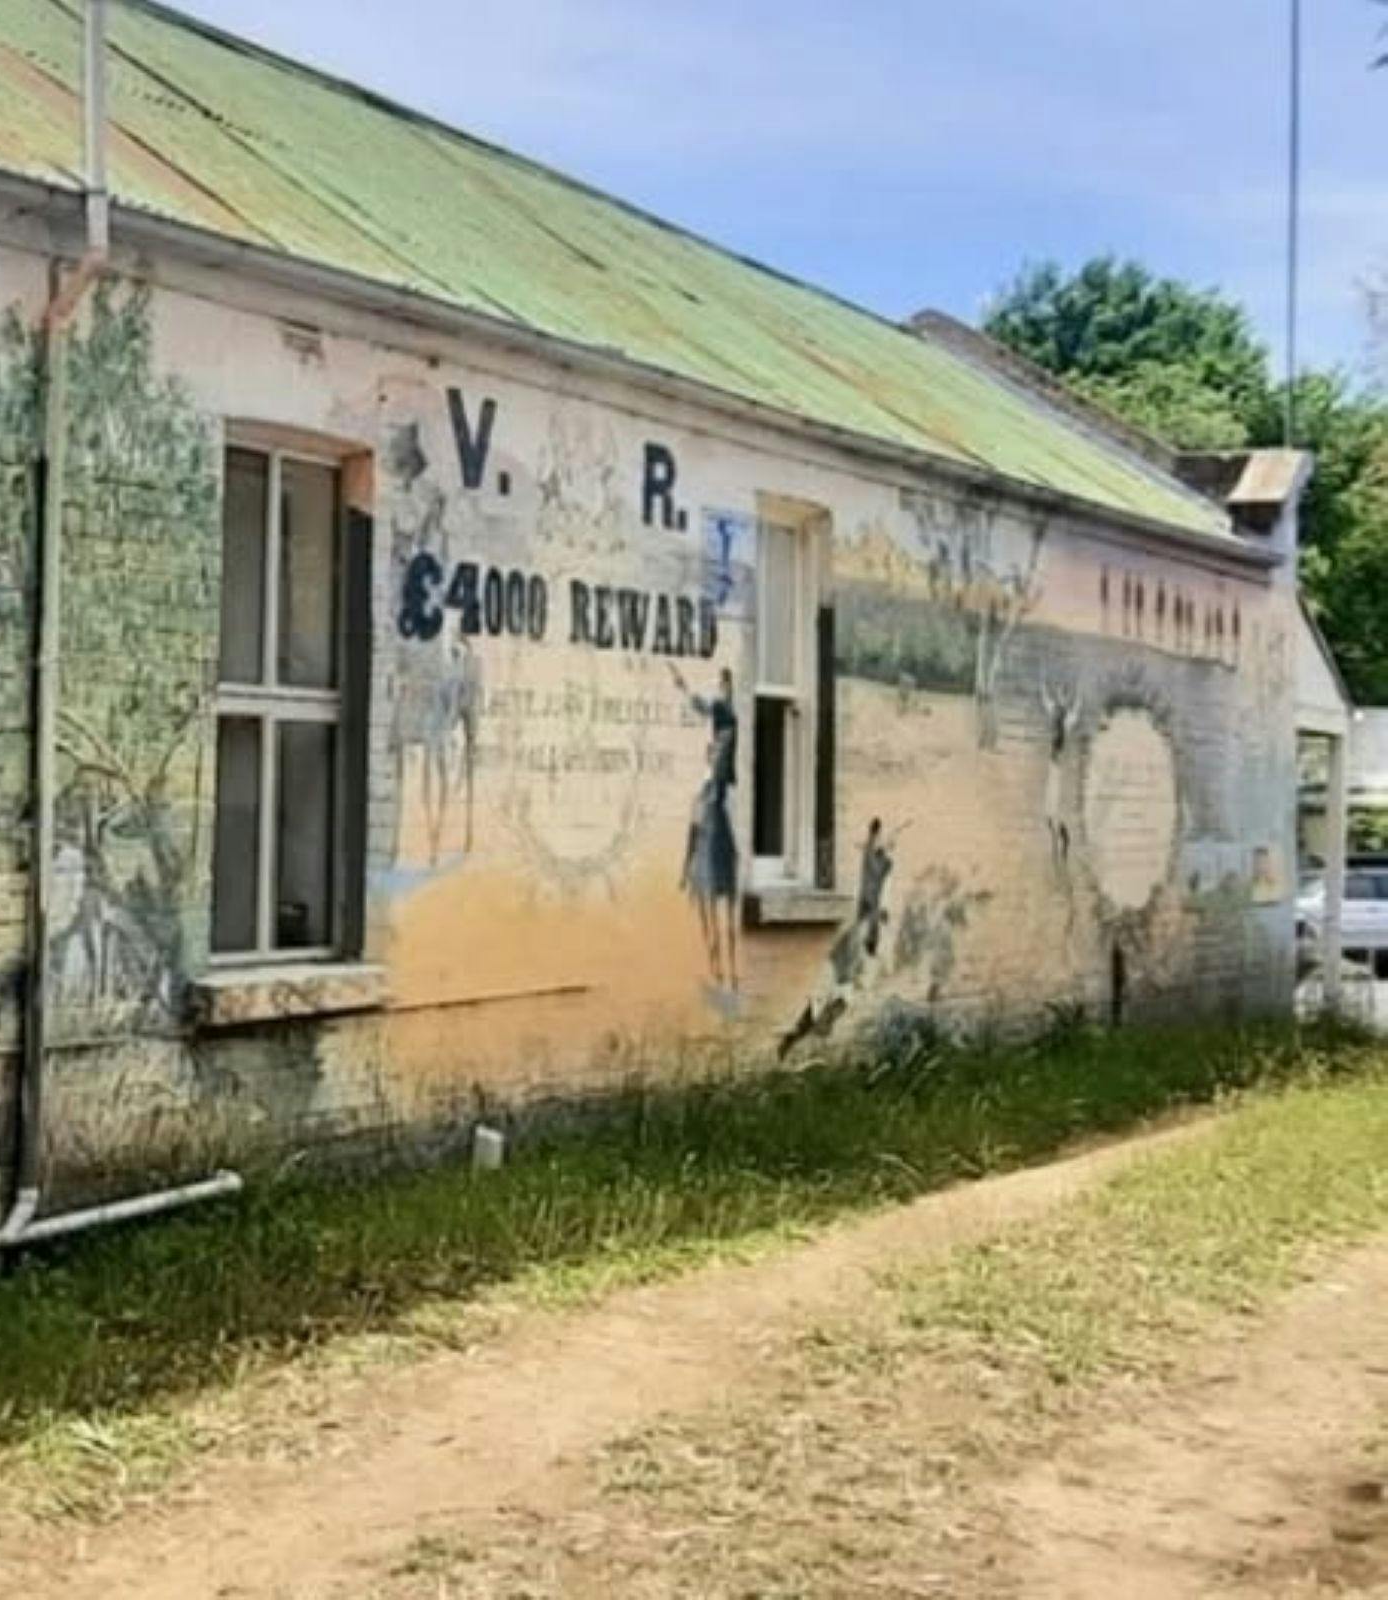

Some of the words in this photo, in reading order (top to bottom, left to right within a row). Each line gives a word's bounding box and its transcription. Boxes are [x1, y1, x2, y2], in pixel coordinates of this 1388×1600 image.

[446, 387, 510, 495] V.
[642, 441, 687, 530] R.
[398, 551, 547, 641] £4000
[569, 579, 718, 658] REWARD
